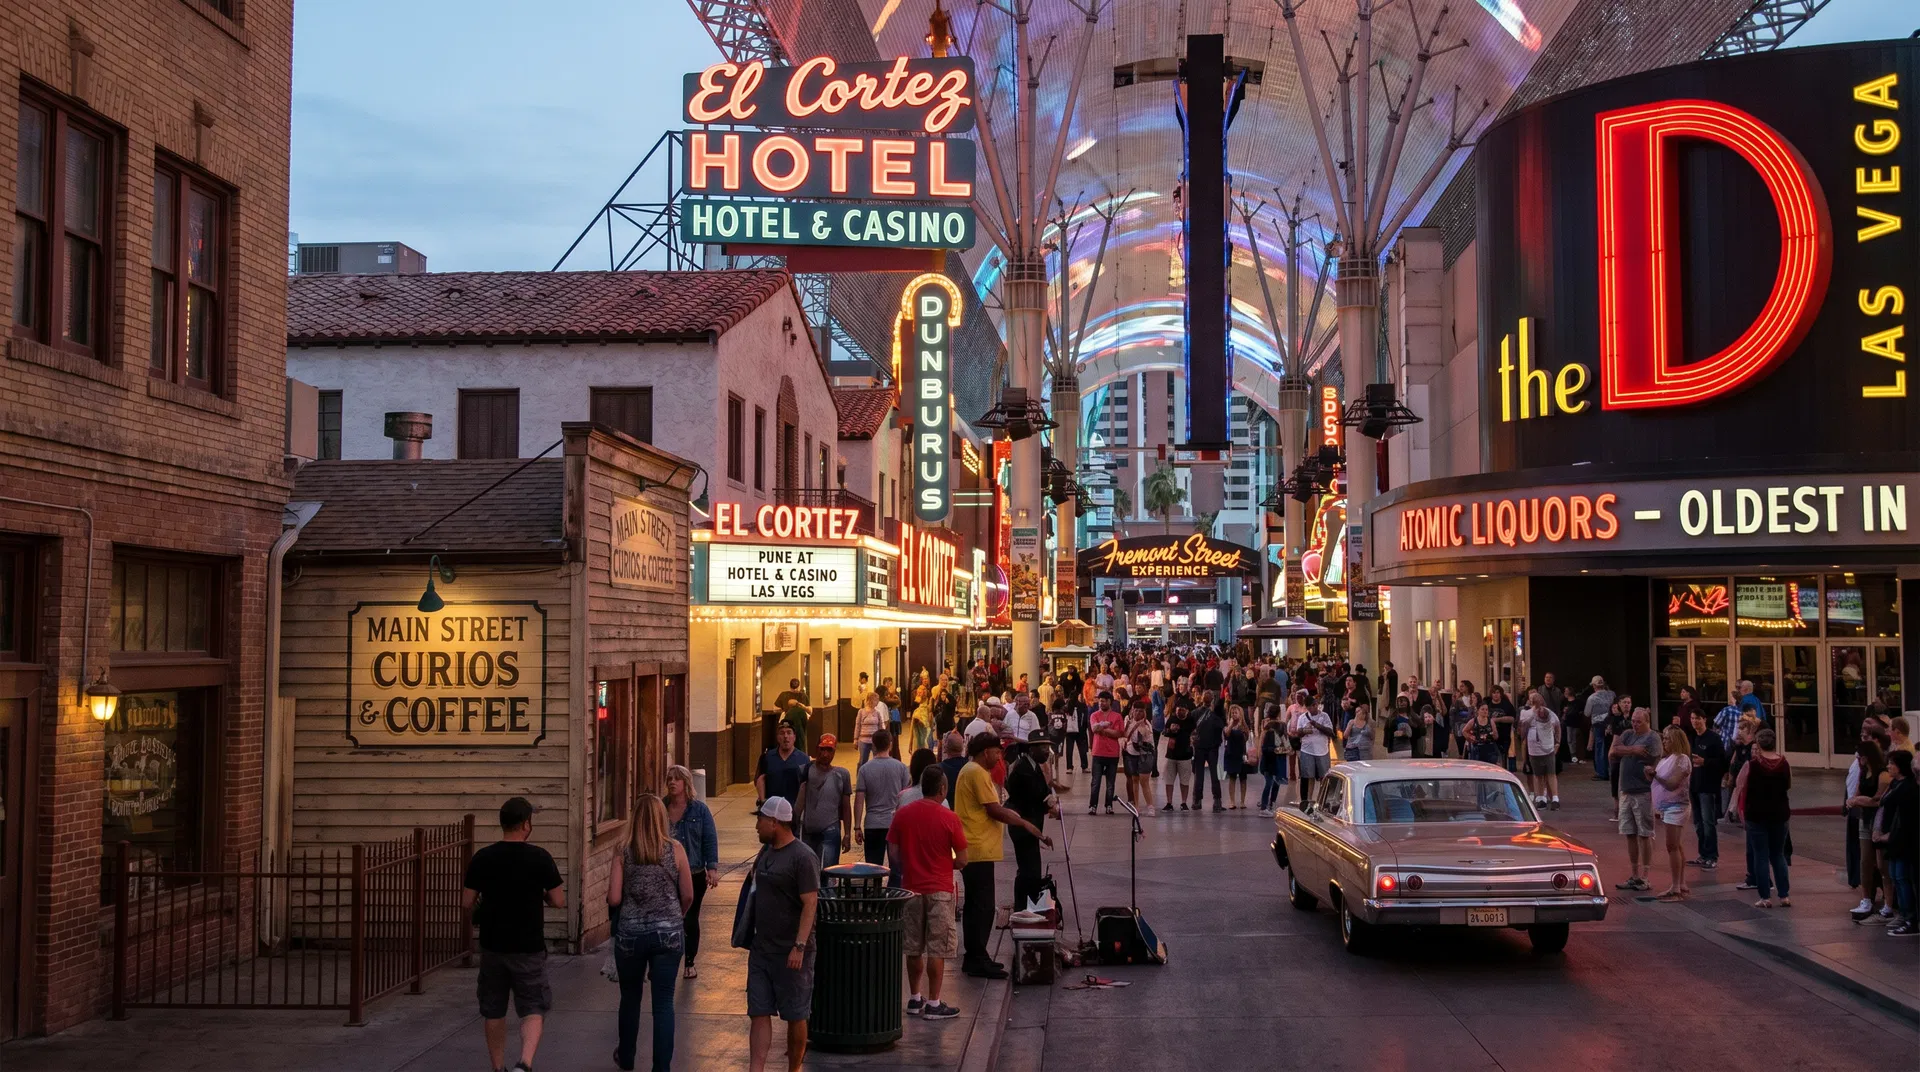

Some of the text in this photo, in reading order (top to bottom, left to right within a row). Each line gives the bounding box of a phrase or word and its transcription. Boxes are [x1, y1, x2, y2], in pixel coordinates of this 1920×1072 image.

[688, 56, 972, 133] El Cortez
[691, 133, 972, 197] HOTEL
[692, 204, 966, 244] HOTEL & CASINO
[1853, 72, 1907, 398] LAS VEGA
[1498, 99, 1824, 422] the D
[921, 296, 943, 510] DUNBURUS
[616, 509, 672, 553] MAIN STREET
[715, 502, 860, 540] EL CORTEZ
[1400, 504, 1463, 551] ATOMIC
[1472, 493, 1618, 547] LIQUORS
[1679, 486, 1844, 536] OLDEST
[1862, 485, 1907, 531] IN
[613, 549, 640, 580] CURIOS
[647, 555, 674, 584] COFFEE
[759, 551, 814, 564] PUNE AT
[901, 522, 915, 602] EL
[918, 531, 956, 607] CORTEZ
[1099, 533, 1241, 573] Fremont Street
[1131, 565, 1209, 576] EXPERIENCE
[728, 567, 838, 582] HOTEL & CASINO
[751, 585, 815, 598] LAS VEGS
[367, 616, 528, 642] MAIN STREET
[373, 651, 520, 688] CURIOS
[386, 696, 530, 734] COFFEE
